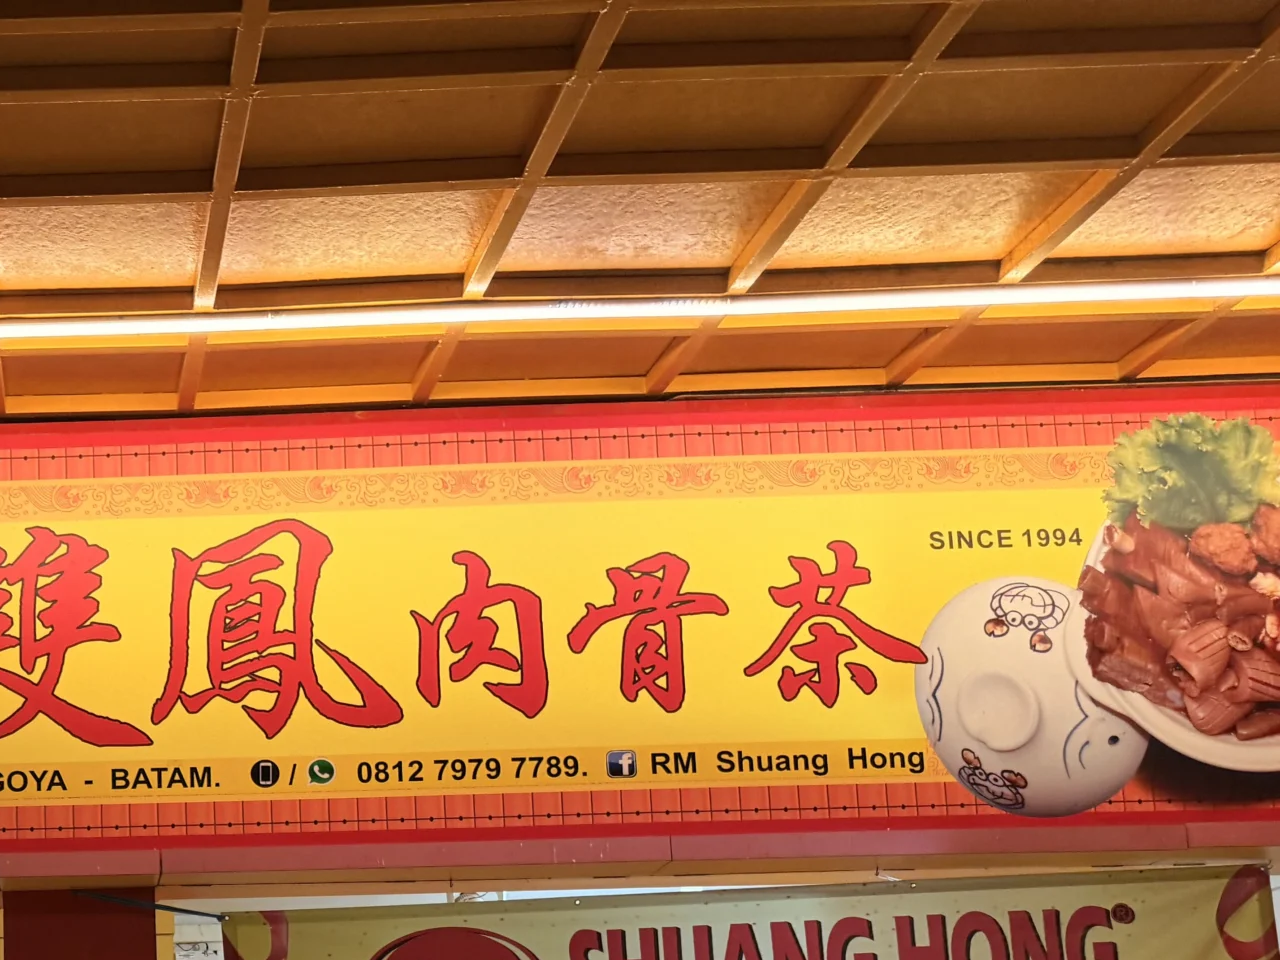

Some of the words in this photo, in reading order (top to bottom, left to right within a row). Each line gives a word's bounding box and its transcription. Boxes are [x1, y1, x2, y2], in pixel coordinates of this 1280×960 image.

[929, 530, 1013, 551] SINCE
[1022, 527, 1083, 548] 1994
[357, 760, 424, 784] 0812
[433, 757, 502, 781] 7979
[511, 755, 589, 780] 7789.
[650, 751, 698, 775] RM
[716, 749, 830, 777] Shuang
[847, 747, 926, 775] Hong
[111, 765, 221, 790] BATAM.
